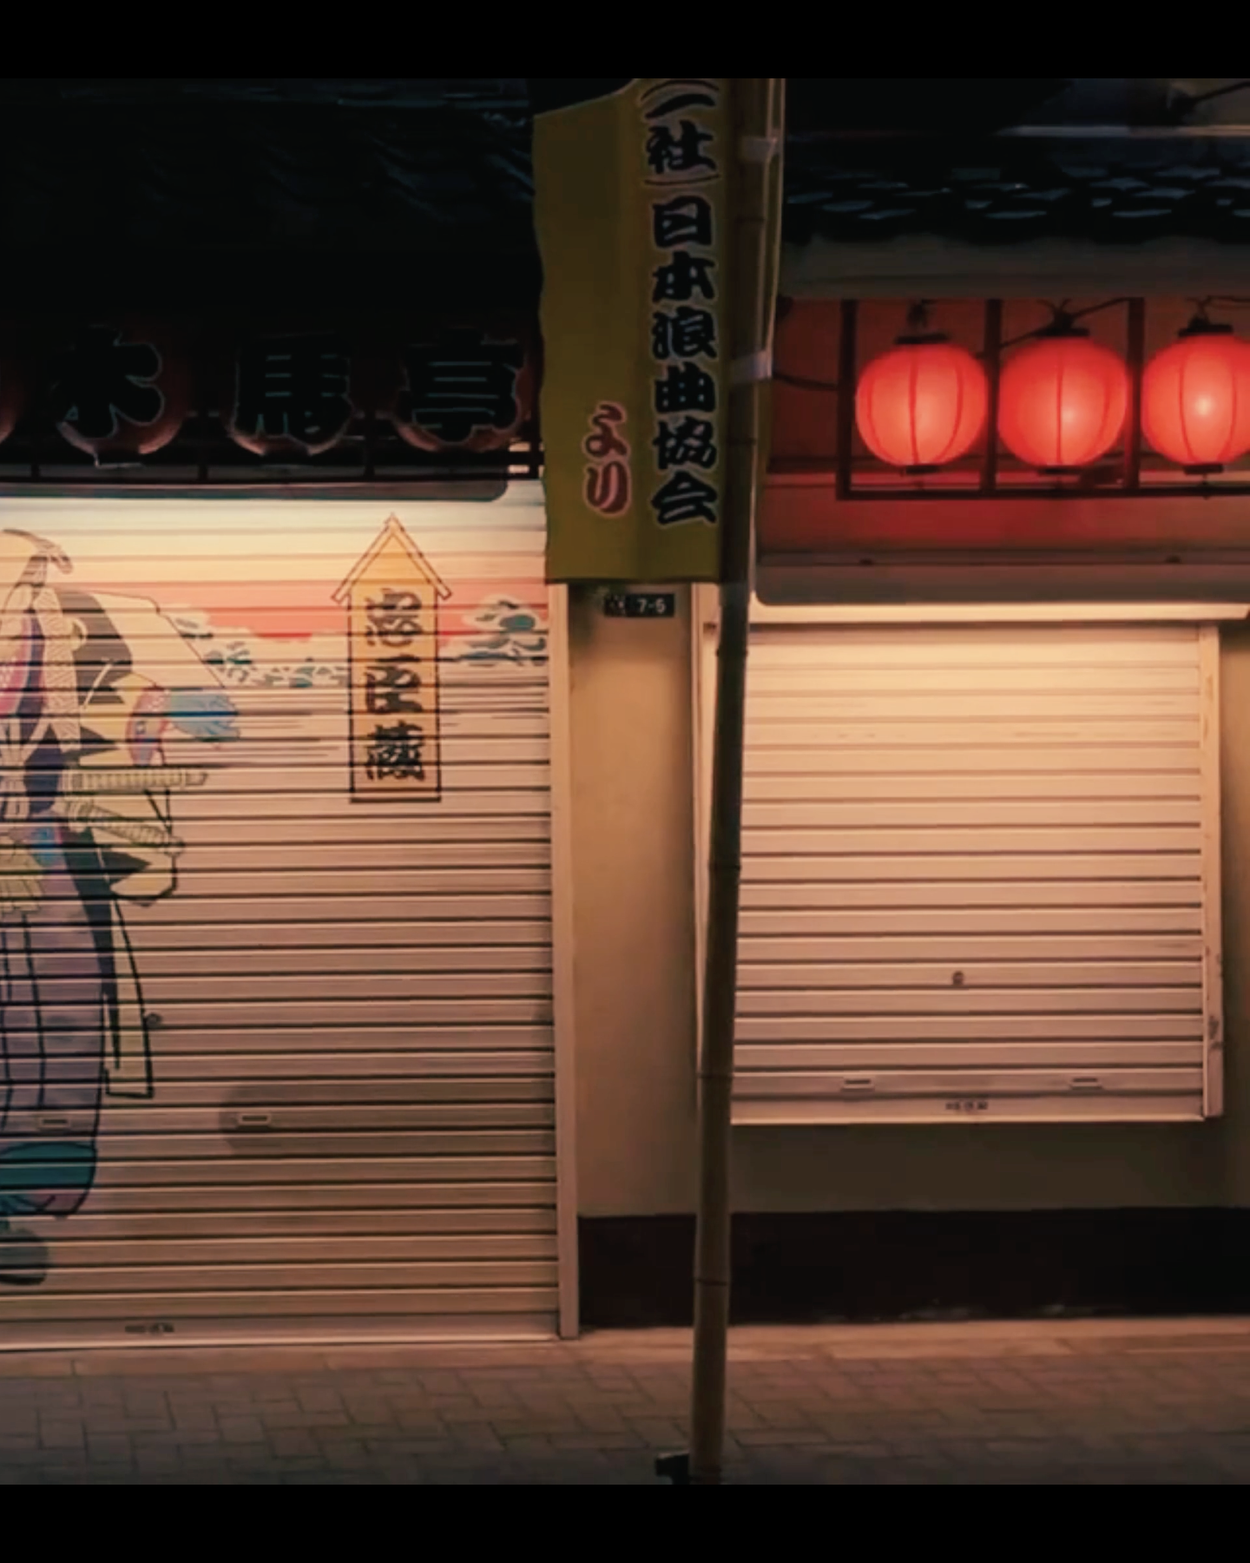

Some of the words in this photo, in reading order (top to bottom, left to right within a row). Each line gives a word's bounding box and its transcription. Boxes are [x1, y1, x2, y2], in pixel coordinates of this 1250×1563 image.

[584, 402, 631, 516] より
[364, 587, 426, 781] 忠臣蔵
